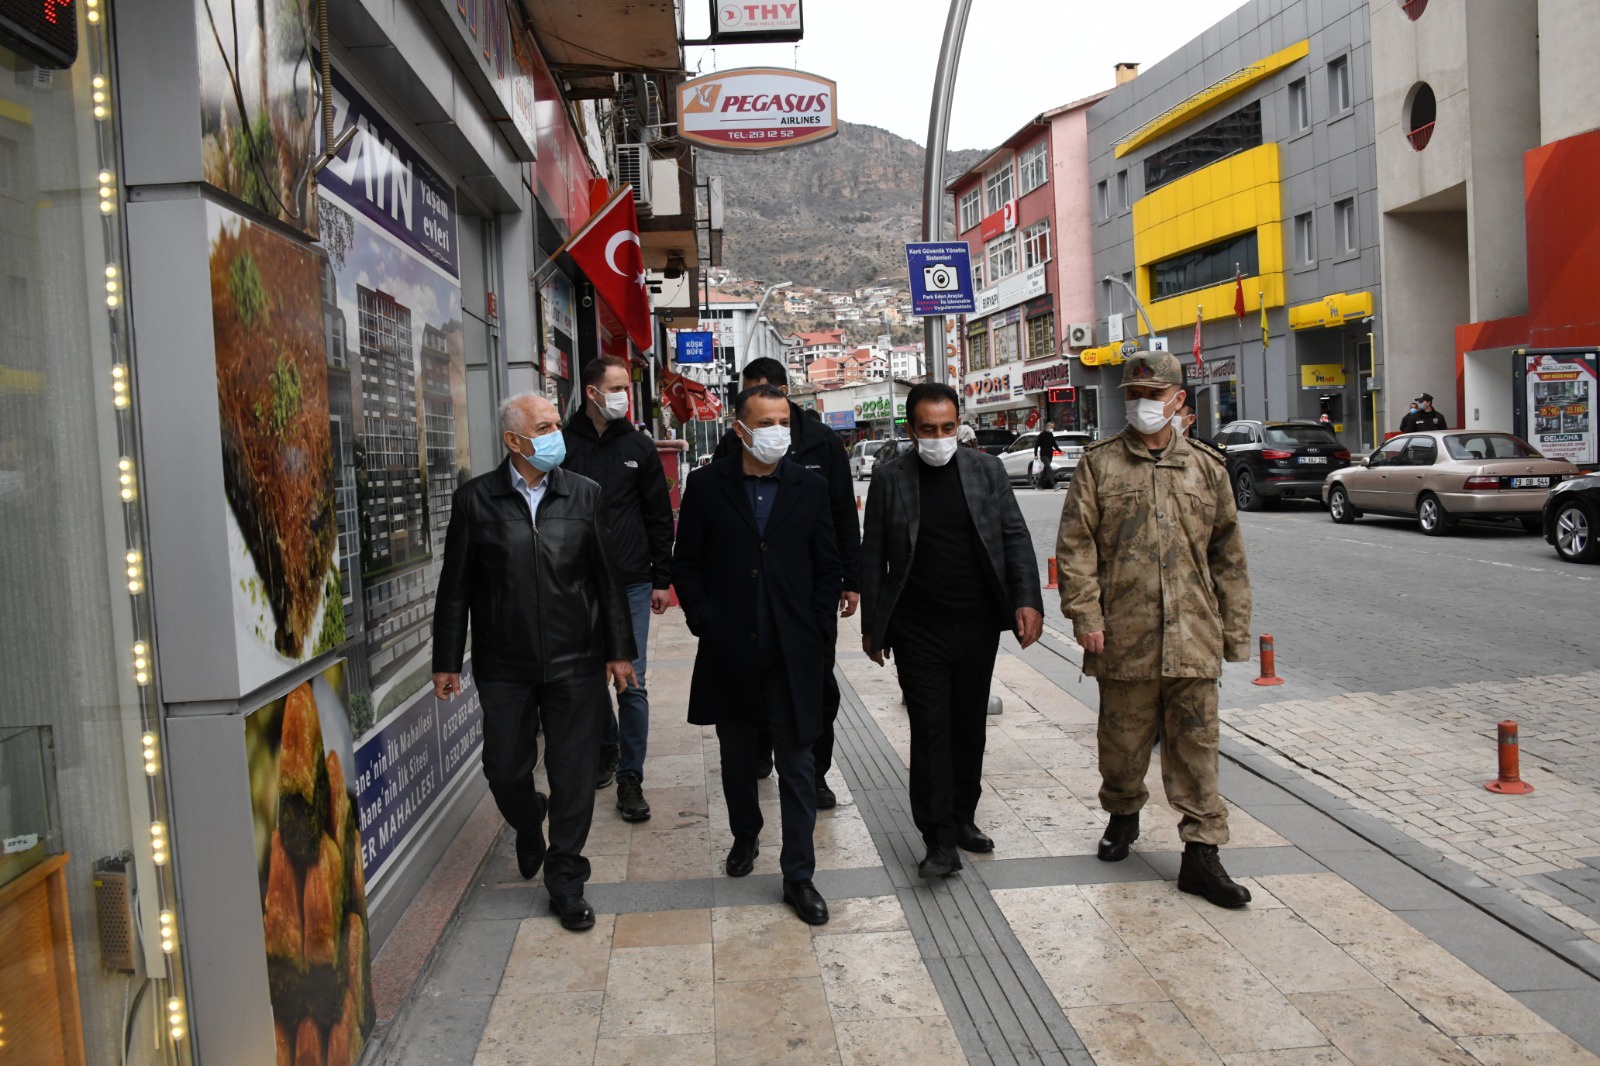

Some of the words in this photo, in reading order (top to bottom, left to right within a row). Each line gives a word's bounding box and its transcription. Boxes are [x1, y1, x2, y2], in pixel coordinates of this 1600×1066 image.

[743, 4, 797, 20] THY
[720, 92, 828, 114] PEGASUS
[780, 116, 821, 125] AIRLINES
[420, 179, 449, 222] yaşam
[423, 214, 450, 252] evleri
[685, 340, 704, 348] KÖŞK
[974, 372, 1010, 396] YÖRE
[862, 397, 890, 412] DOĞA
[1543, 434, 1579, 442] BELLONA
[1514, 478, 1522, 486] 29
[1537, 478, 1548, 486] 544
[387, 738, 399, 767] İlk
[400, 708, 433, 755] Mahallesi
[443, 723, 448, 741] 0
[447, 713, 458, 737] 532
[397, 765, 409, 792] İlk
[409, 743, 429, 780] Sitesi
[445, 754, 450, 773] 0
[450, 742, 460, 768] 532
[378, 765, 435, 850] MAHALLESİ
